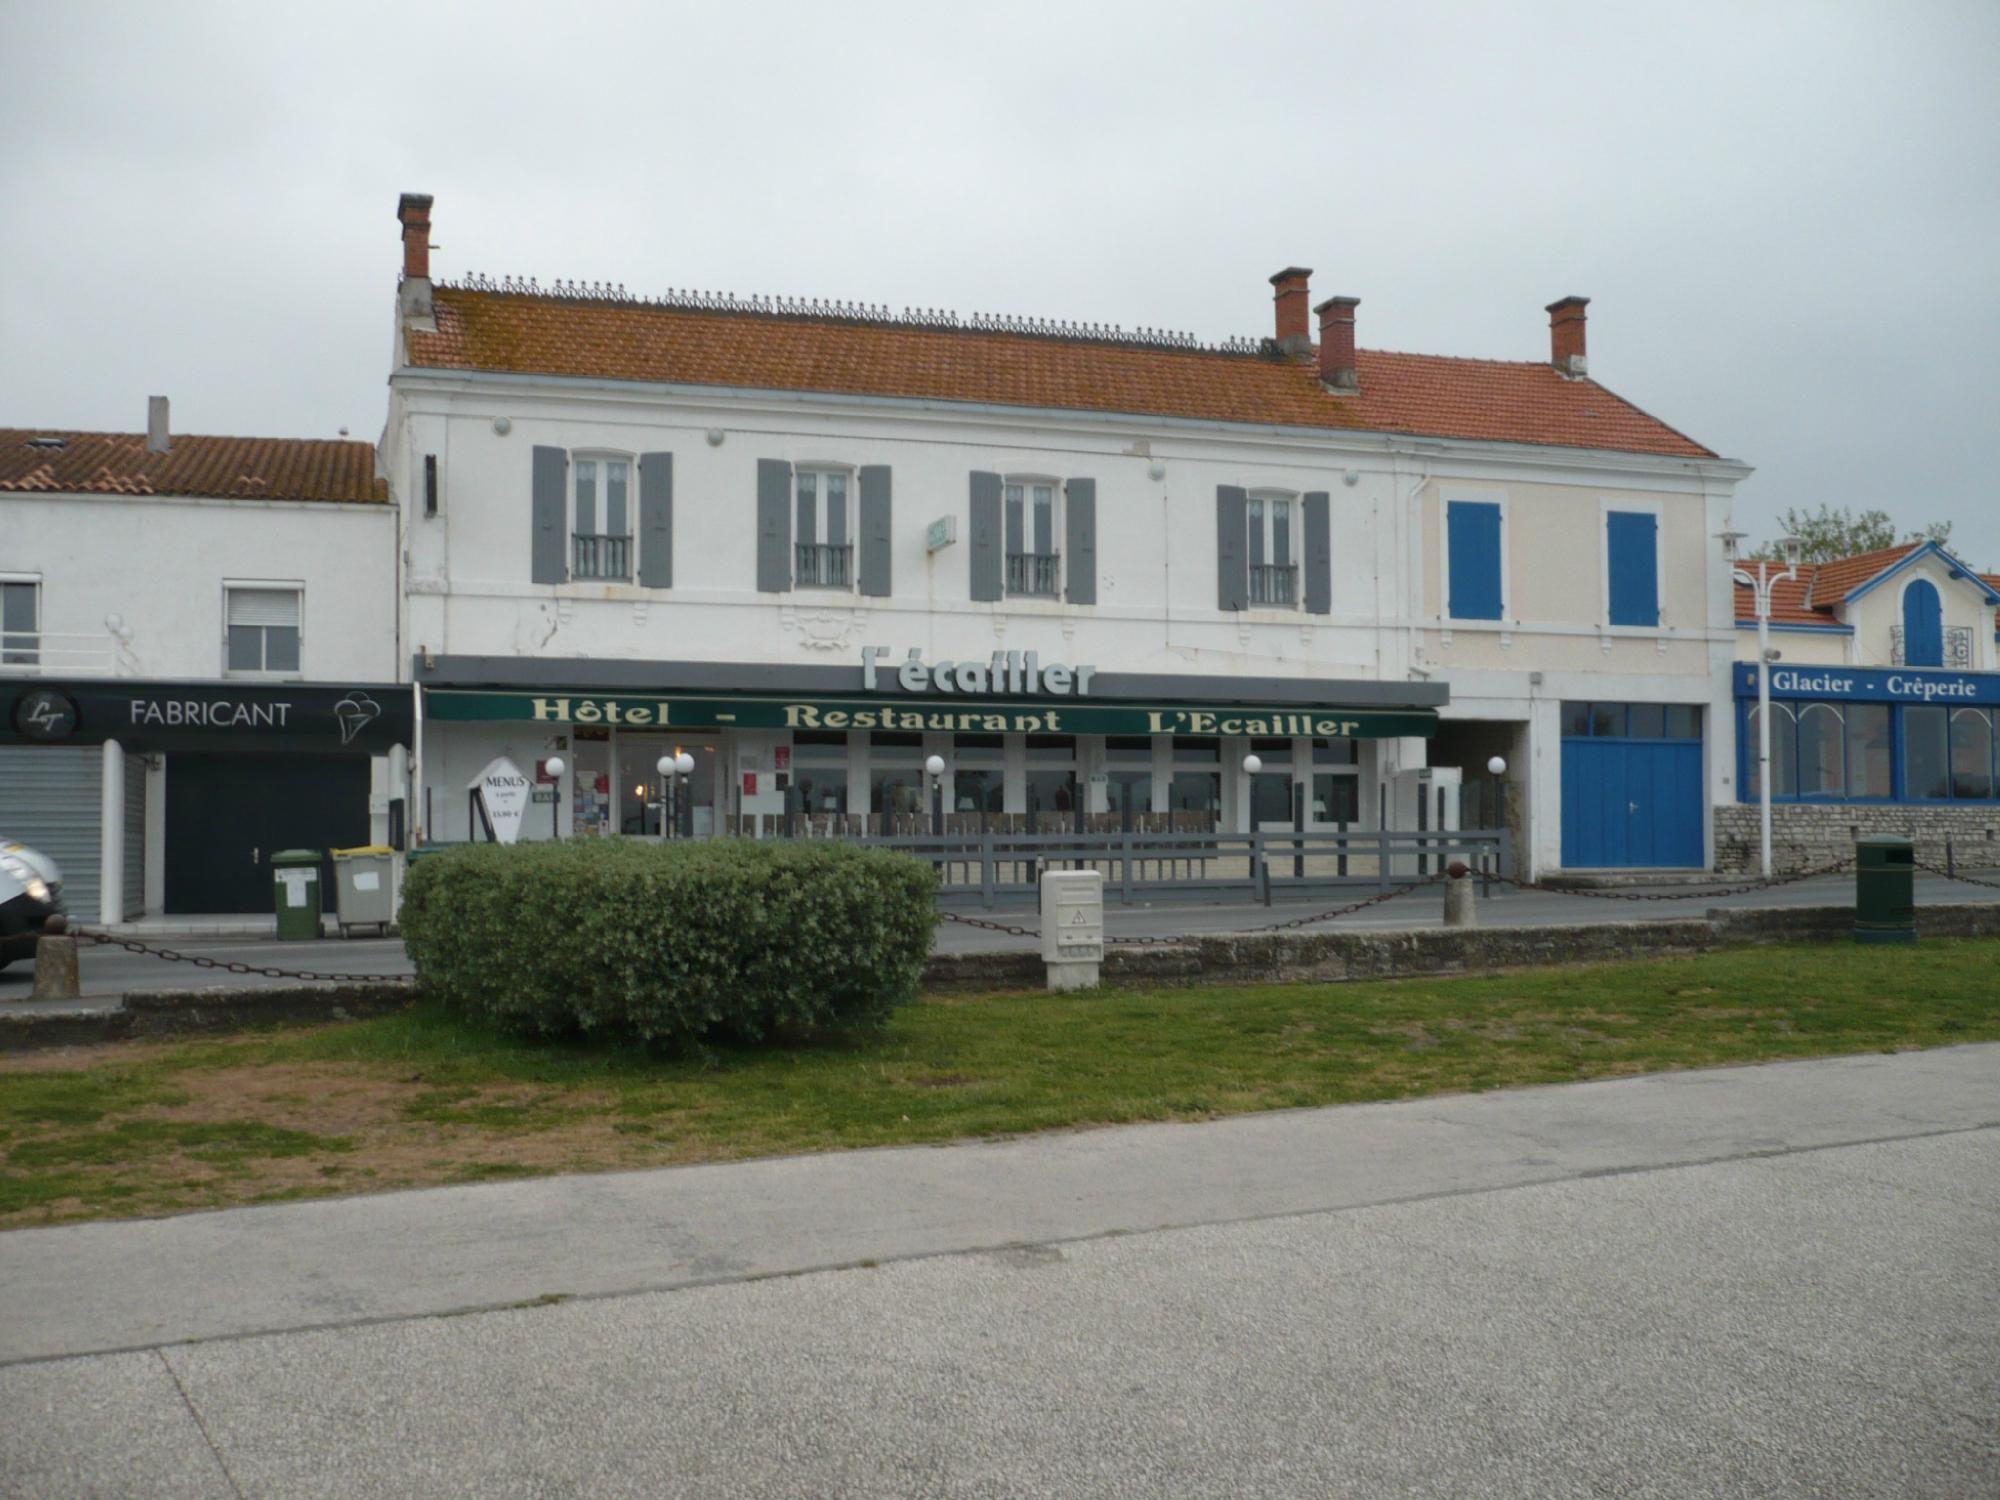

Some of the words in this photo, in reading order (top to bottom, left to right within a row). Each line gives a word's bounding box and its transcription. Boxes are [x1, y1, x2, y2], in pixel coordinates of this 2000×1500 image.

[1772, 671, 1854, 693] Glacier
[1887, 675, 1977, 701] Crêperie
[130, 700, 292, 727] FABRICANT
[532, 698, 670, 725] Hôtel
[782, 705, 1062, 733] Restaurant
[1148, 711, 1360, 736] L'Ecailler
[486, 776, 525, 788] MENUS
